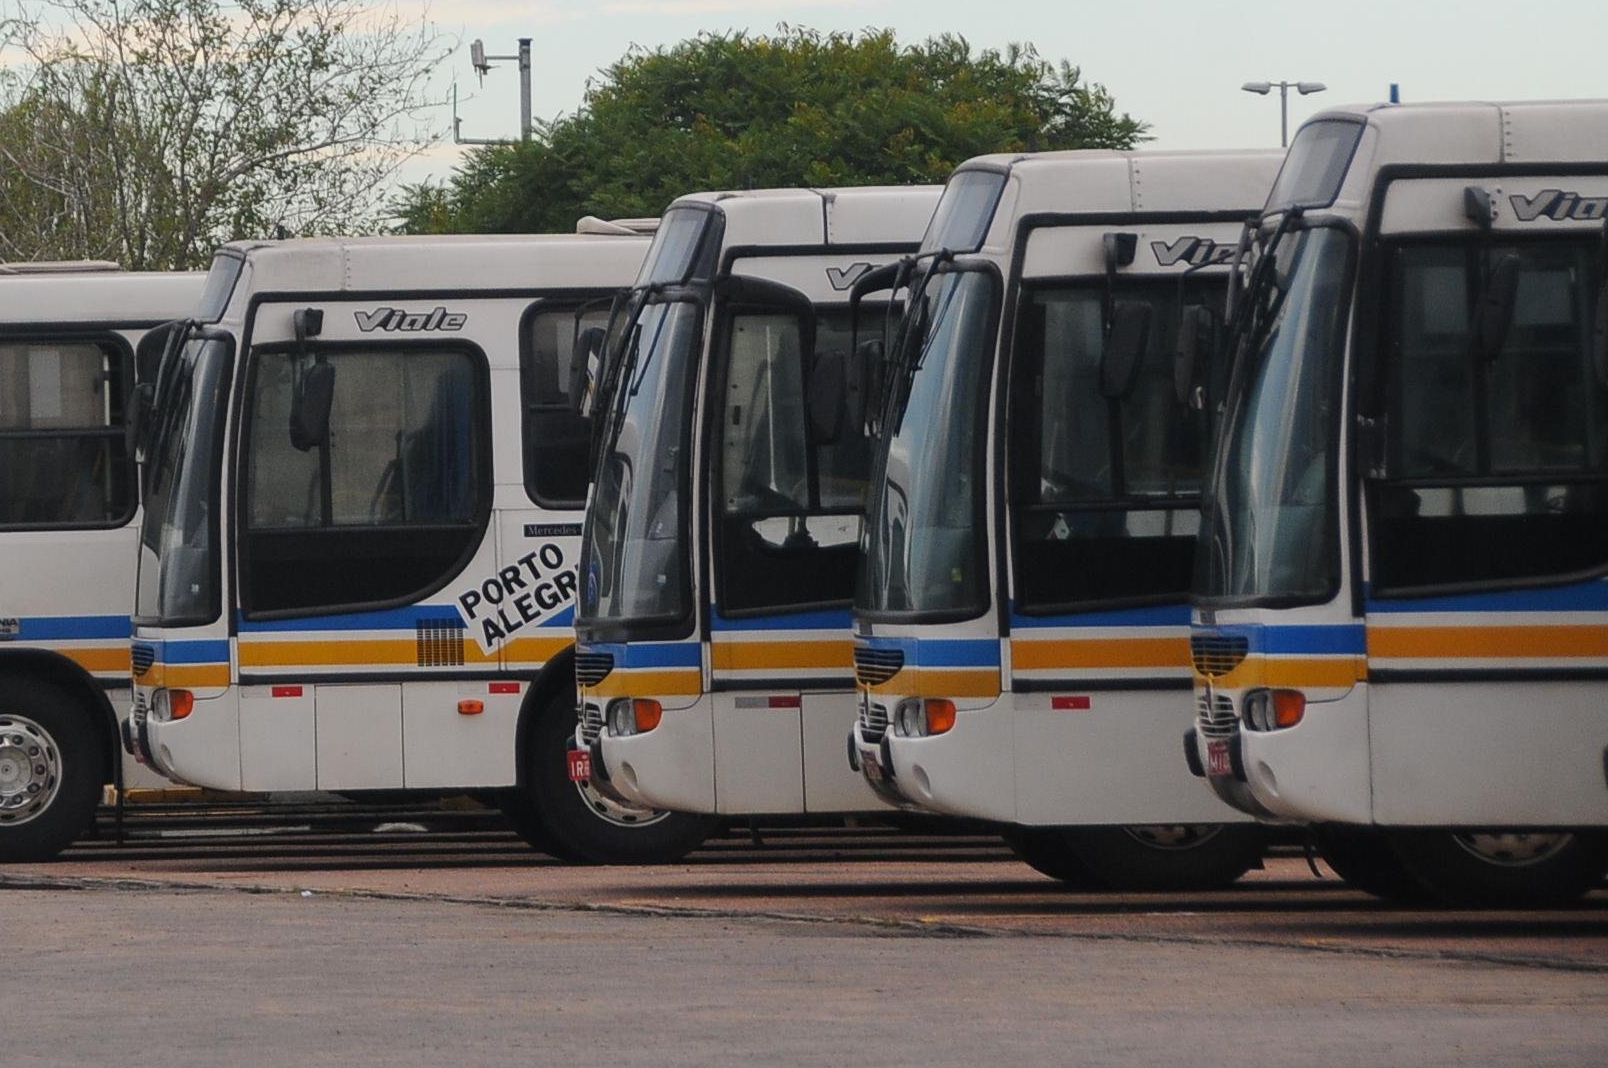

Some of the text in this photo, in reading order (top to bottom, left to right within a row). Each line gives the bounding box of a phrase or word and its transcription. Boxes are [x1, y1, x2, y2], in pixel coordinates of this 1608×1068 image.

[354, 307, 468, 332] Viale
[458, 543, 564, 620] PORTO
[481, 563, 579, 648] ALEGR
